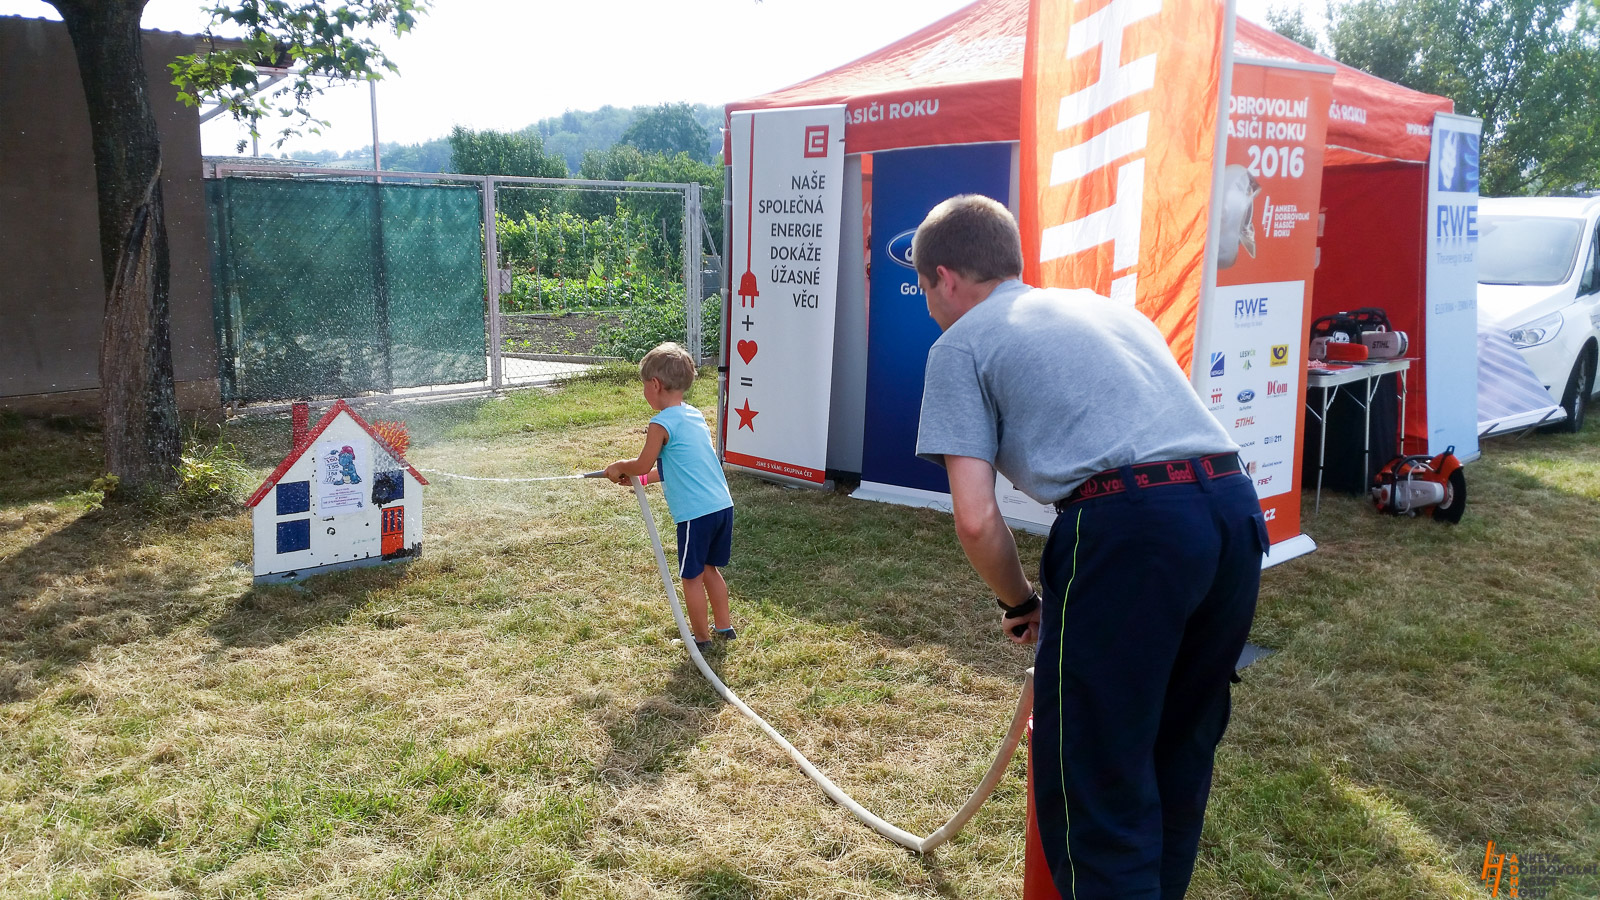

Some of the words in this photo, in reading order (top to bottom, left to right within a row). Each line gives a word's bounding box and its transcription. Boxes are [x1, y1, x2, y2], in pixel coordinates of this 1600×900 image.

[845, 102, 884, 125] ASIČI
[889, 98, 940, 119] ROKU
[1229, 96, 1309, 119] OBROVOLNÍ
[1227, 117, 1263, 139] ASIČI
[1266, 122, 1307, 141] ROKU
[1247, 145, 1305, 178] 2016
[791, 170, 826, 190] NAŠE
[758, 195, 824, 214] SPOLEČNÁ
[1275, 204, 1297, 212] ANKETA
[770, 223, 823, 238] ENERGIE
[1437, 205, 1478, 237] RWE
[770, 242, 822, 262] DOKÁŽE
[771, 266, 820, 286] ÚŽASNÉ
[900, 282, 917, 295] Go
[792, 290, 819, 309] VĚCI
[1234, 297, 1268, 316] RWE
[1372, 340, 1390, 349] STIHL
[1267, 380, 1288, 395] DCom
[1235, 416, 1255, 428] STIHL
[783, 467, 803, 476] SKUPINA
[803, 470, 813, 478] ČEZ
[1166, 463, 1192, 480] Good
